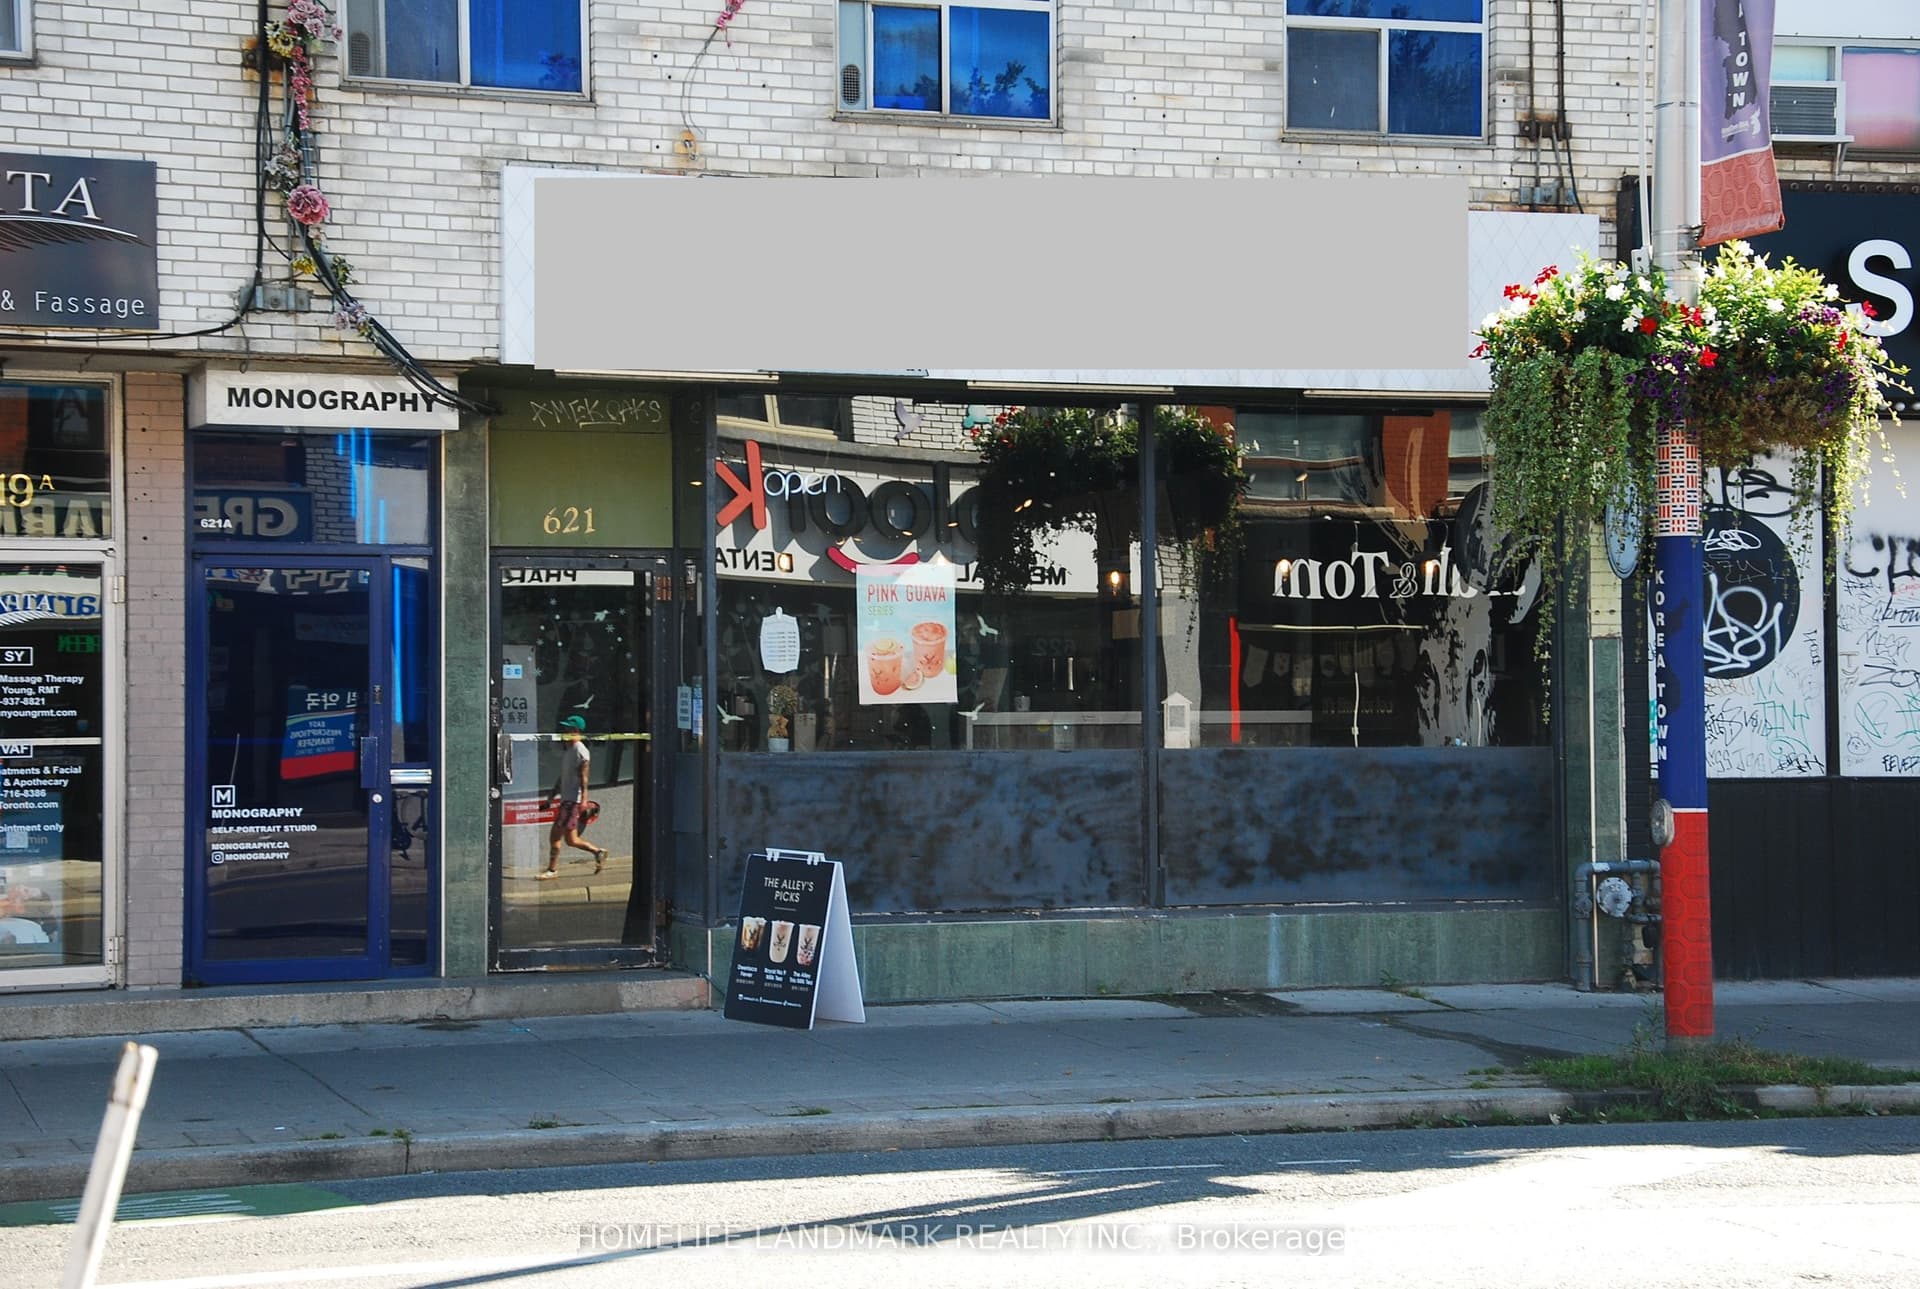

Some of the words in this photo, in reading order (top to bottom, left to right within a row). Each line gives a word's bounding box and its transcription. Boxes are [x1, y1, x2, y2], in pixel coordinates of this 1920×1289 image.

[1732, 32, 1748, 108] TOWN
[0, 170, 102, 220] TA
[1, 290, 15, 310] &
[35, 291, 145, 318] Fassage
[227, 387, 438, 413] MONOGRAPHY
[763, 470, 841, 501] open
[200, 518, 232, 528] 621A
[543, 507, 597, 534] 621
[867, 584, 899, 602] PINK
[906, 584, 947, 602] GUAVA
[868, 605, 894, 616] SERIES
[4, 650, 25, 662] SY
[45, 674, 84, 684] Therapy
[38, 686, 60, 694] RMT
[43, 766, 51, 775] &
[53, 765, 82, 774] Facial
[3, 778, 11, 787] &
[13, 778, 69, 788] Apothecary
[216, 789, 231, 803] M
[212, 808, 303, 819] MONOGRAPHY
[43, 822, 64, 832] only
[212, 825, 281, 834] SELF-PORTRAIT
[283, 824, 317, 833] STUDIO
[212, 841, 290, 851] MONOGRAPHY.CA
[225, 852, 289, 861] MONOGRAPHY
[764, 877, 780, 889] THE
[781, 878, 815, 892] ALLEY'S
[774, 891, 801, 903] PICKS
